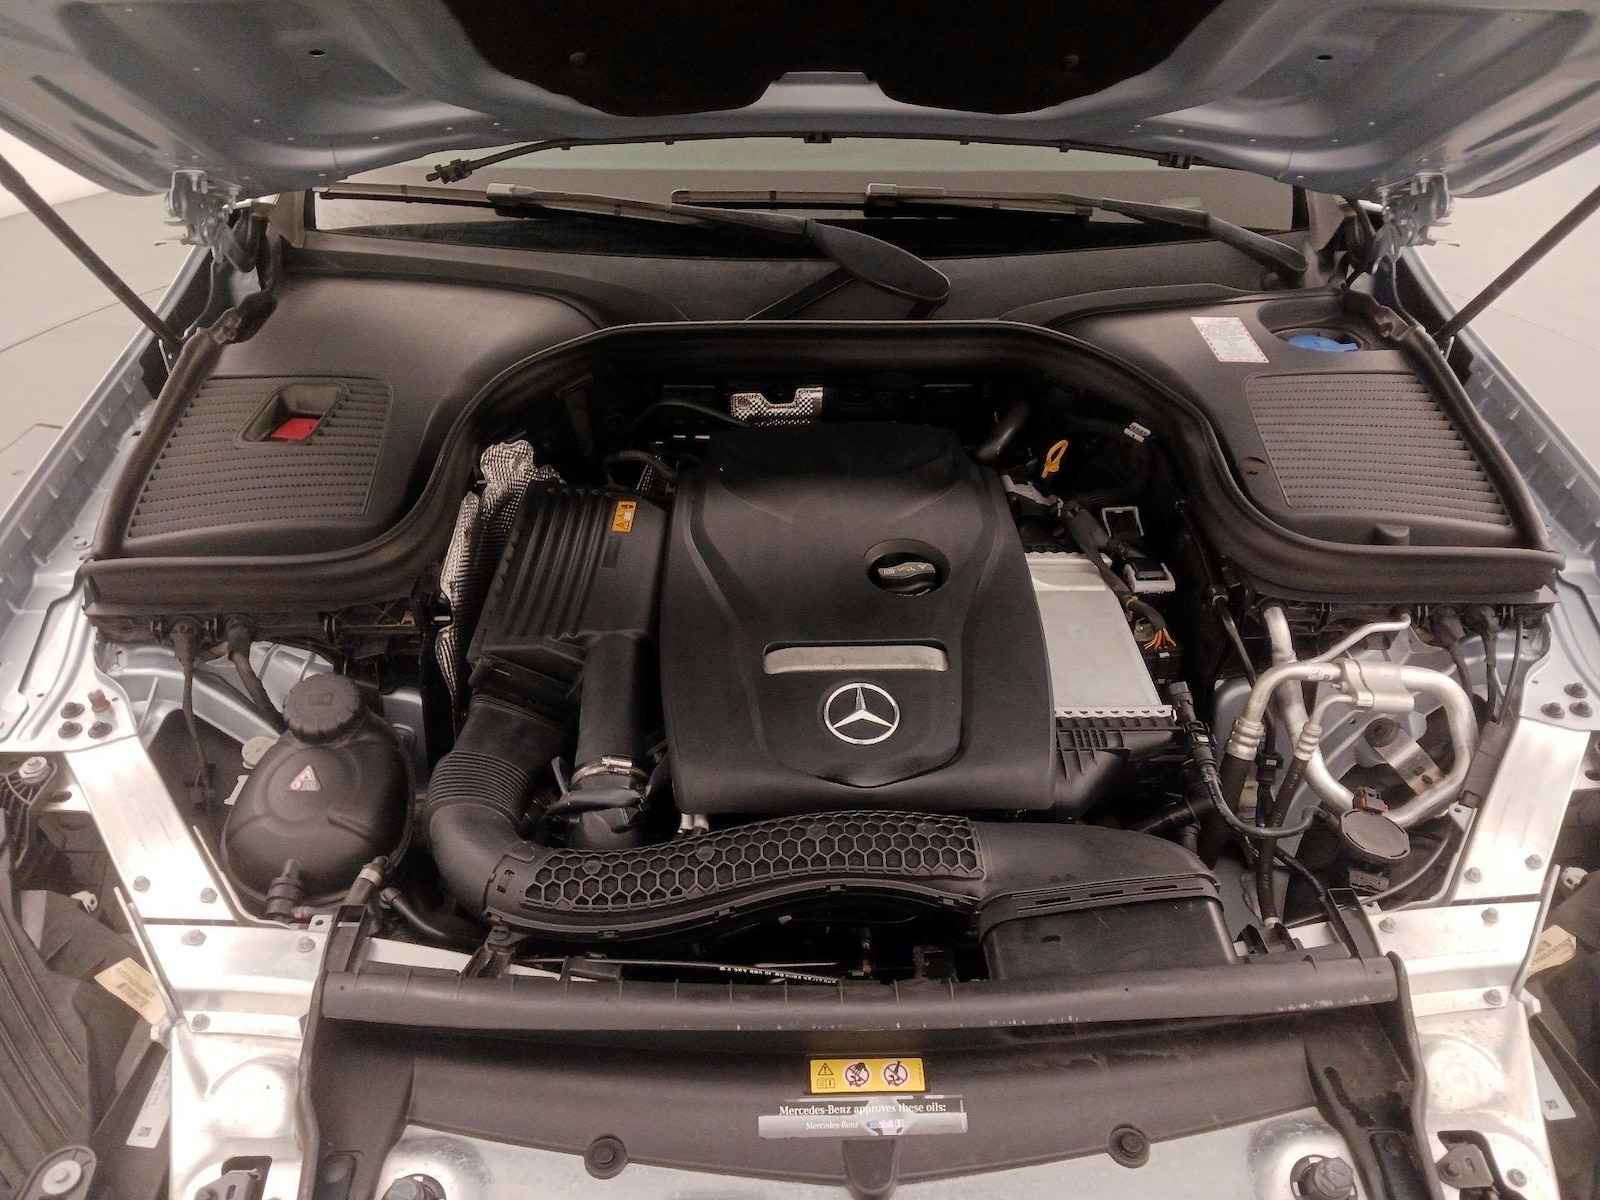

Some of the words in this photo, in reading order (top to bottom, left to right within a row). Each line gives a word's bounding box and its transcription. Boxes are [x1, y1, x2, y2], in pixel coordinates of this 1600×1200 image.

[779, 1104, 852, 1116] Mercedes-Benz
[853, 1104, 897, 1116] approves
[899, 1102, 924, 1113] these
[926, 1102, 947, 1112] oils:
